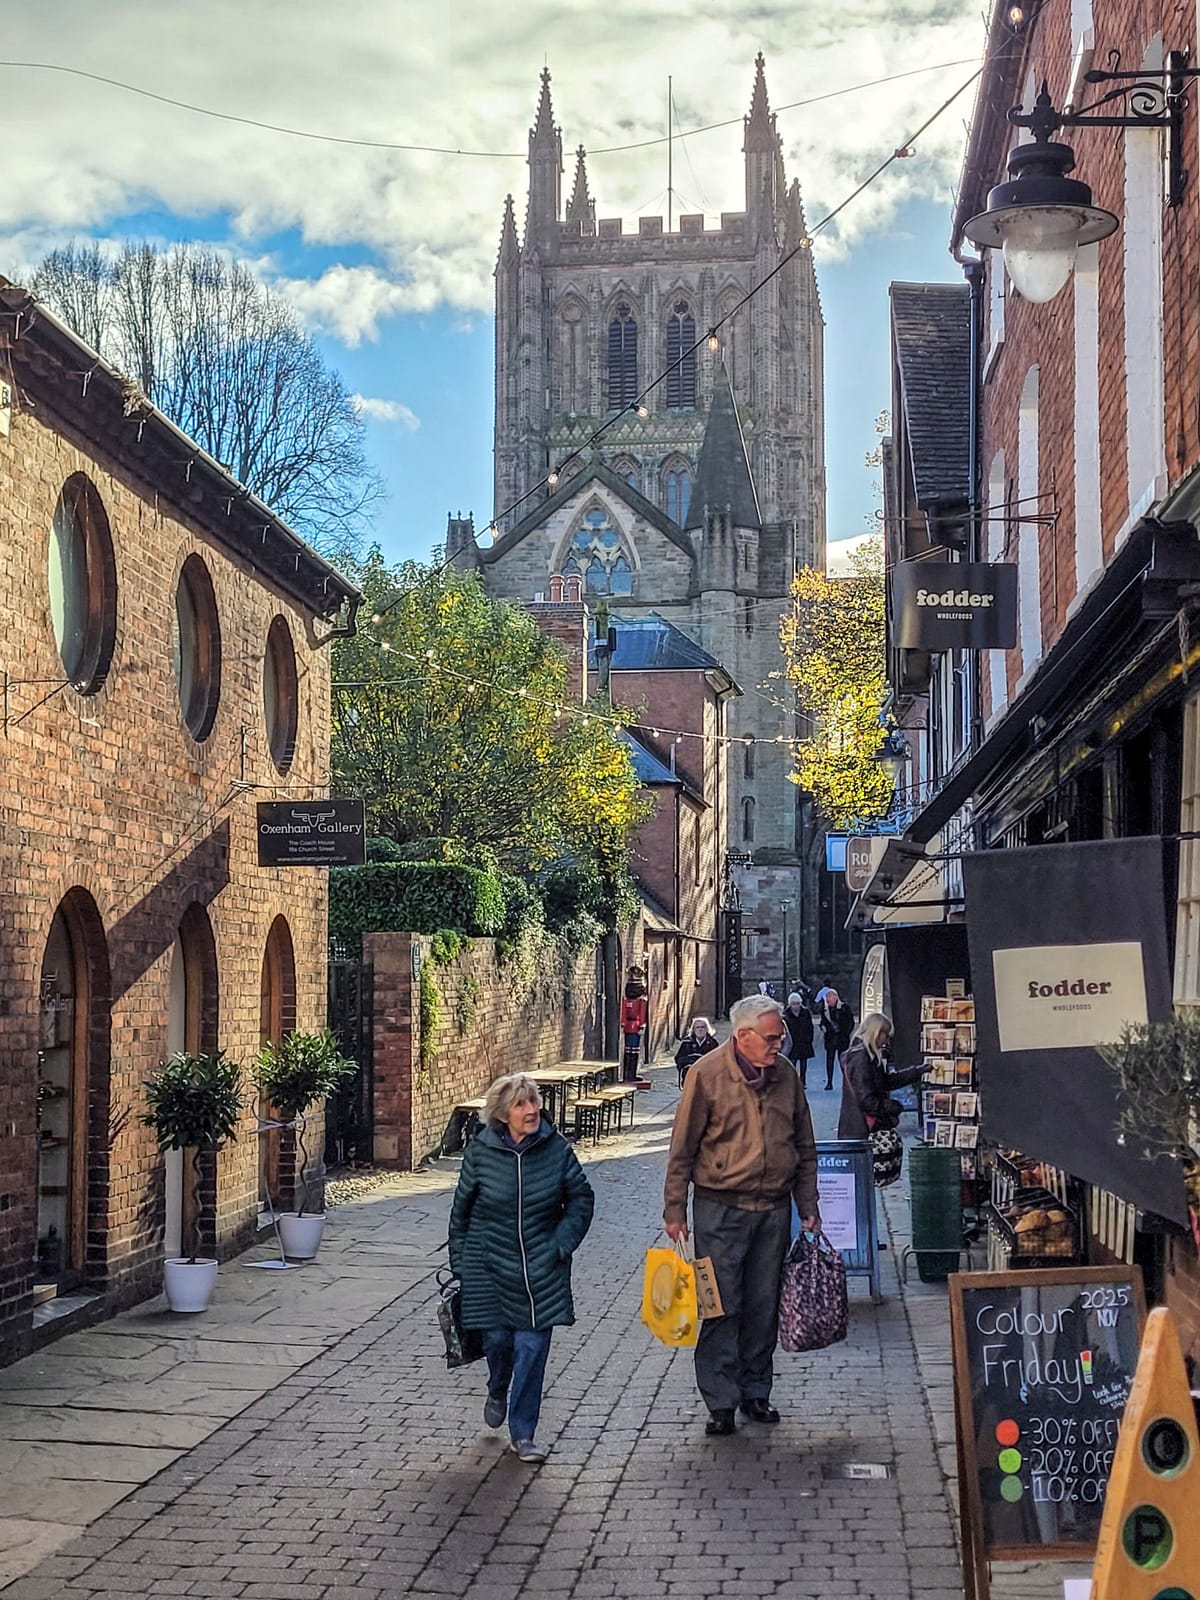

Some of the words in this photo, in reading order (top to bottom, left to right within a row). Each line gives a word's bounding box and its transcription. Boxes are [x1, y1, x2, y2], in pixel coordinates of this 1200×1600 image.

[917, 589, 994, 607] fodder
[260, 823, 311, 834] Oxenham
[318, 821, 362, 835] Gallery
[1028, 978, 1112, 998] fodder
[1052, 1003, 1092, 1011] WHOLEFOODS
[818, 1156, 849, 1168] dder
[976, 1305, 1075, 1336] Colour
[1097, 1308, 1120, 1327] NOV
[1081, 1478, 1107, 1502] OF
